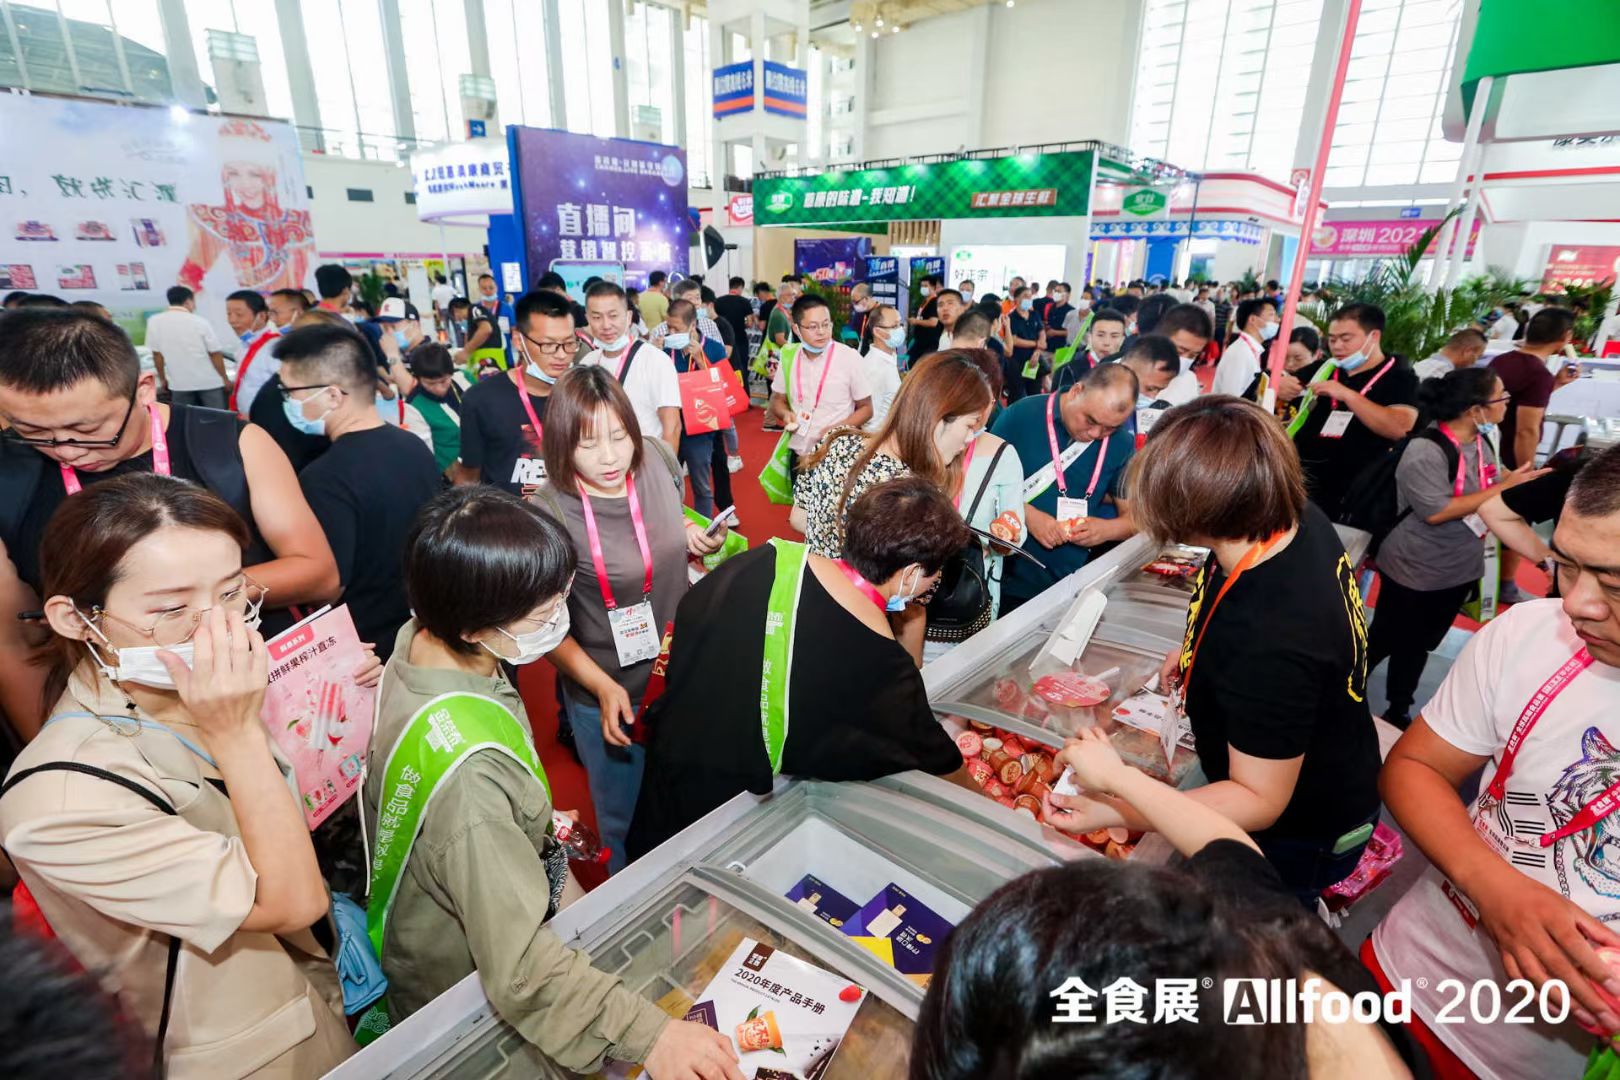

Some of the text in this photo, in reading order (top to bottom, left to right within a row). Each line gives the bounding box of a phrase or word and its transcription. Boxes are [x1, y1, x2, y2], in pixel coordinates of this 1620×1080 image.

[557, 202, 636, 237] 直播间
[1340, 227, 1377, 243] 深圳
[734, 968, 826, 1016] 2020年度产品手册
